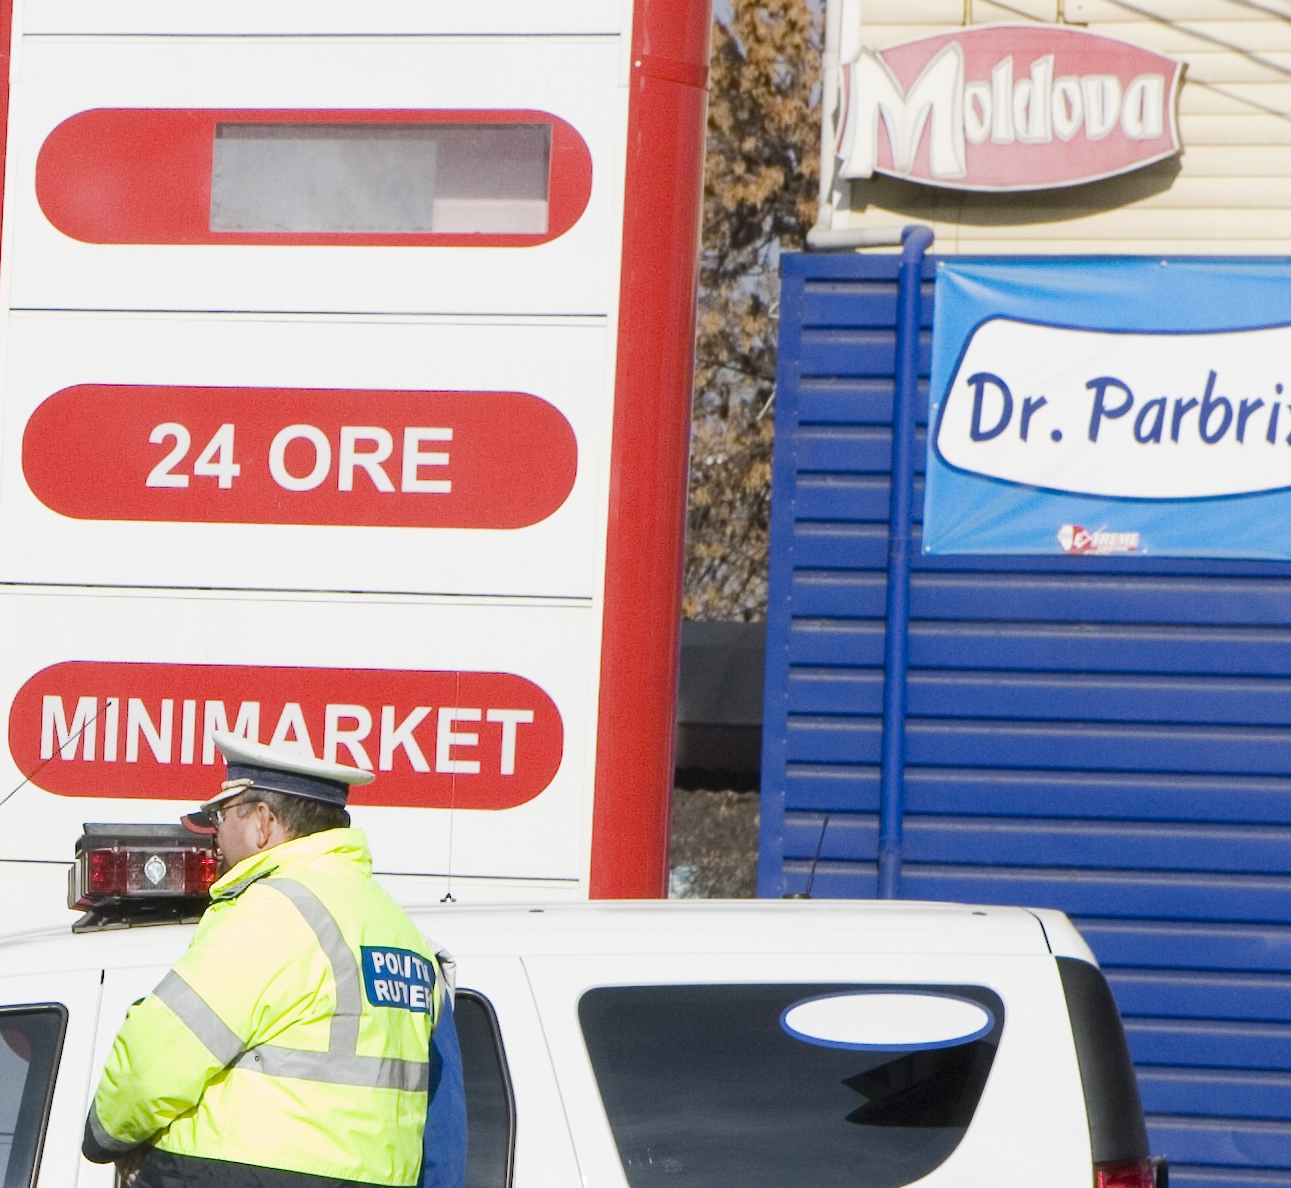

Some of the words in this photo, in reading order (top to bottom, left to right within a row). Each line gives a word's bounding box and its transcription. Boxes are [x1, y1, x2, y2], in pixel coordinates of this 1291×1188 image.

[838, 41, 1165, 179] Moldova
[966, 371, 1064, 443] Dr.
[1085, 369, 1291, 446] Parbri
[145, 422, 241, 489] 24
[268, 424, 454, 494] ORE
[39, 694, 535, 776] MINIMARKET
